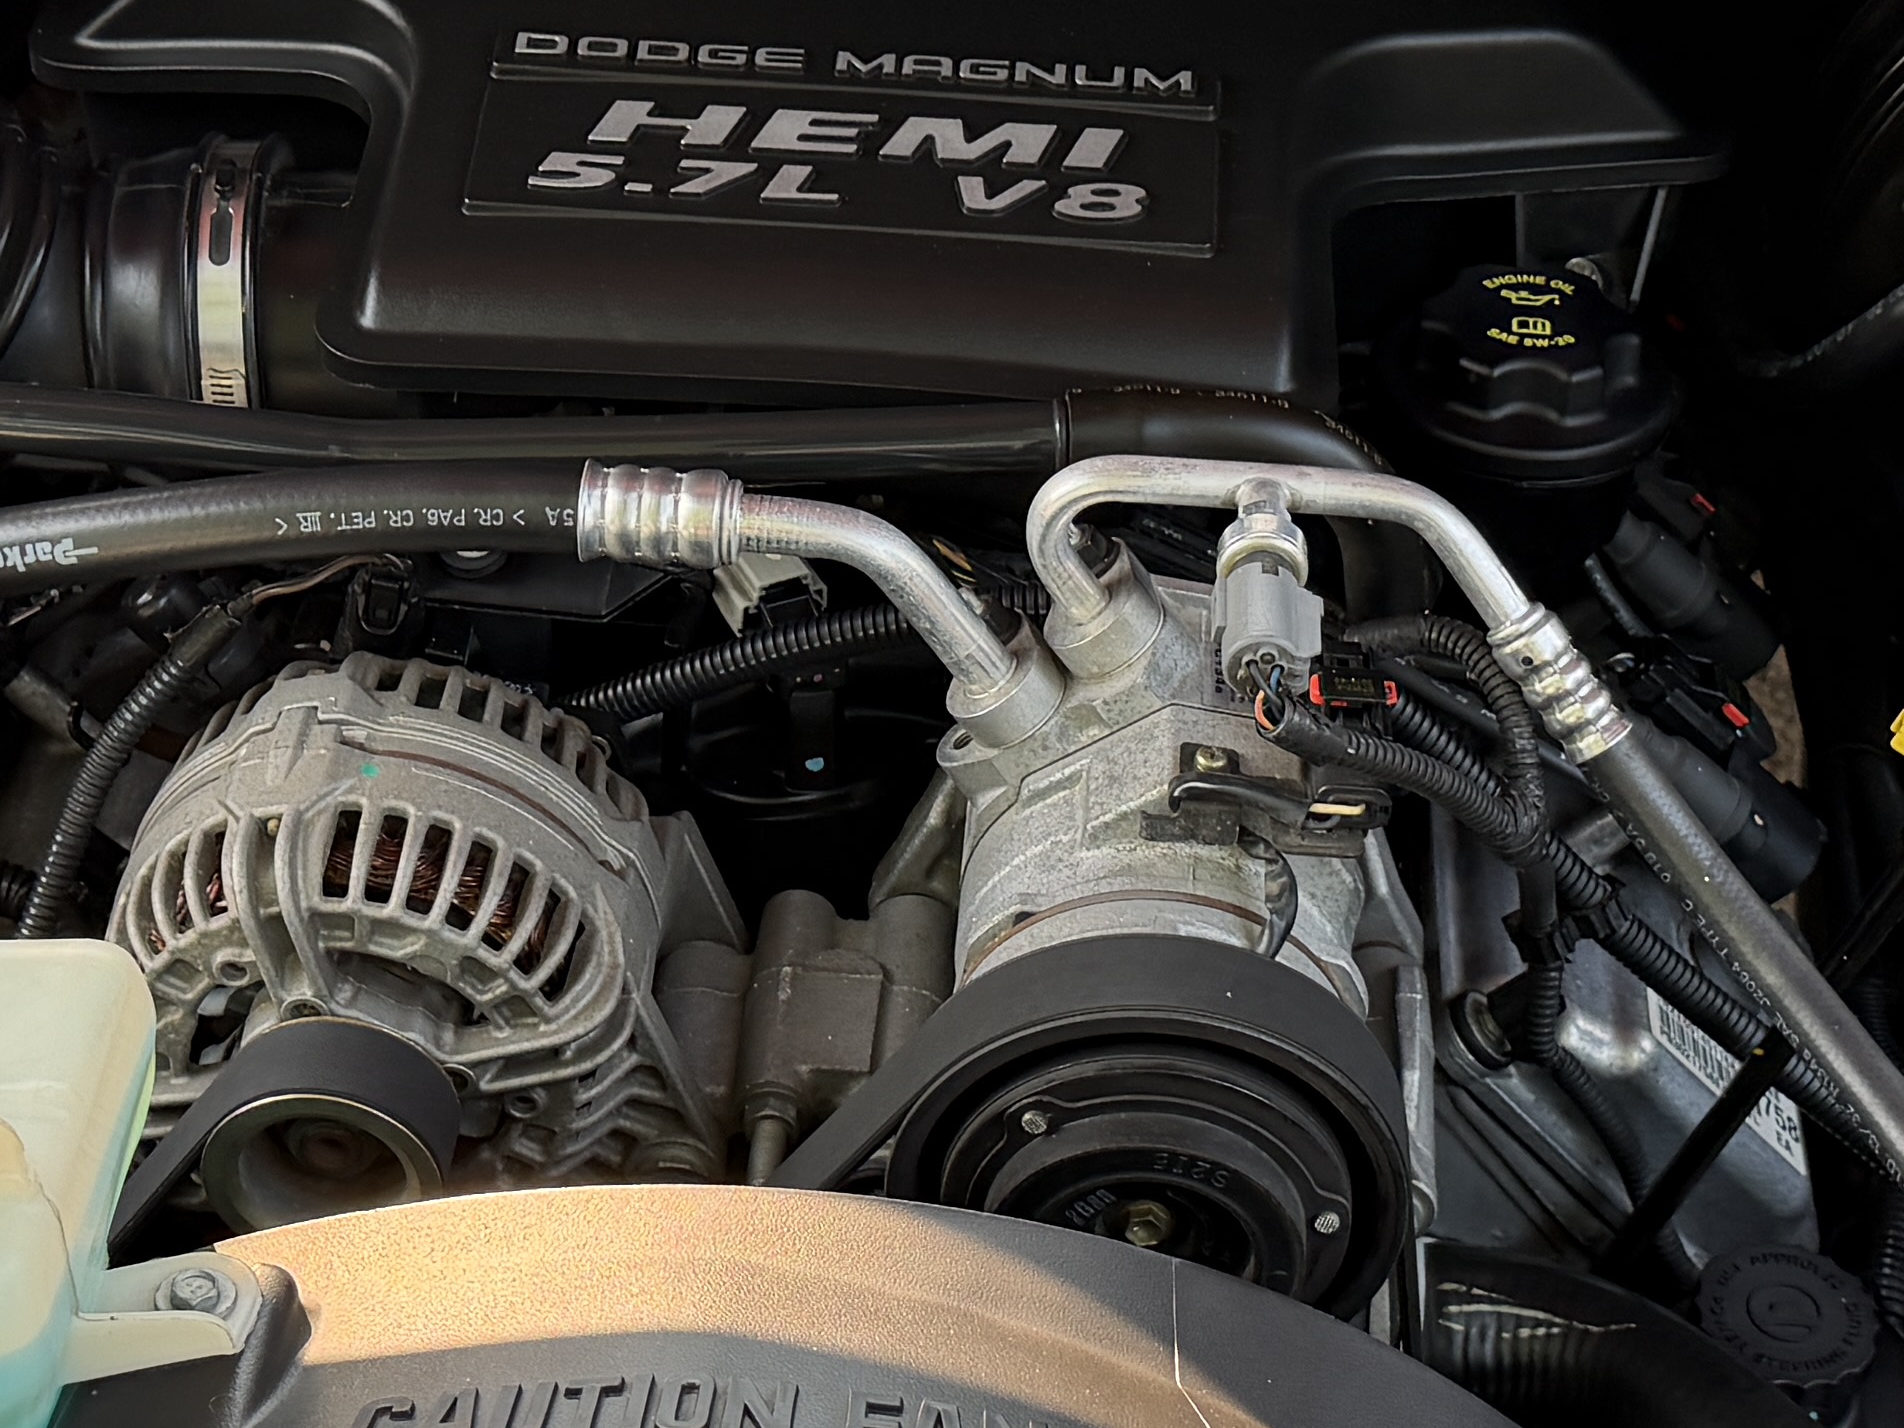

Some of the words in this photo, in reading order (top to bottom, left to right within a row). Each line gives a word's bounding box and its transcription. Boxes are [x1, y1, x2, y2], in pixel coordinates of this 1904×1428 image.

[514, 30, 805, 71] DODGE
[833, 48, 1199, 95] MAGNUM
[587, 100, 1129, 173] HEMI
[527, 151, 843, 208] 5.7L
[956, 176, 1151, 223] V8
[1482, 274, 1547, 289] ENGINE
[1549, 279, 1576, 295] OIL
[1486, 328, 1520, 345] SAE
[1523, 334, 1576, 348] 5W-20
[328, 505, 377, 536] PET.
